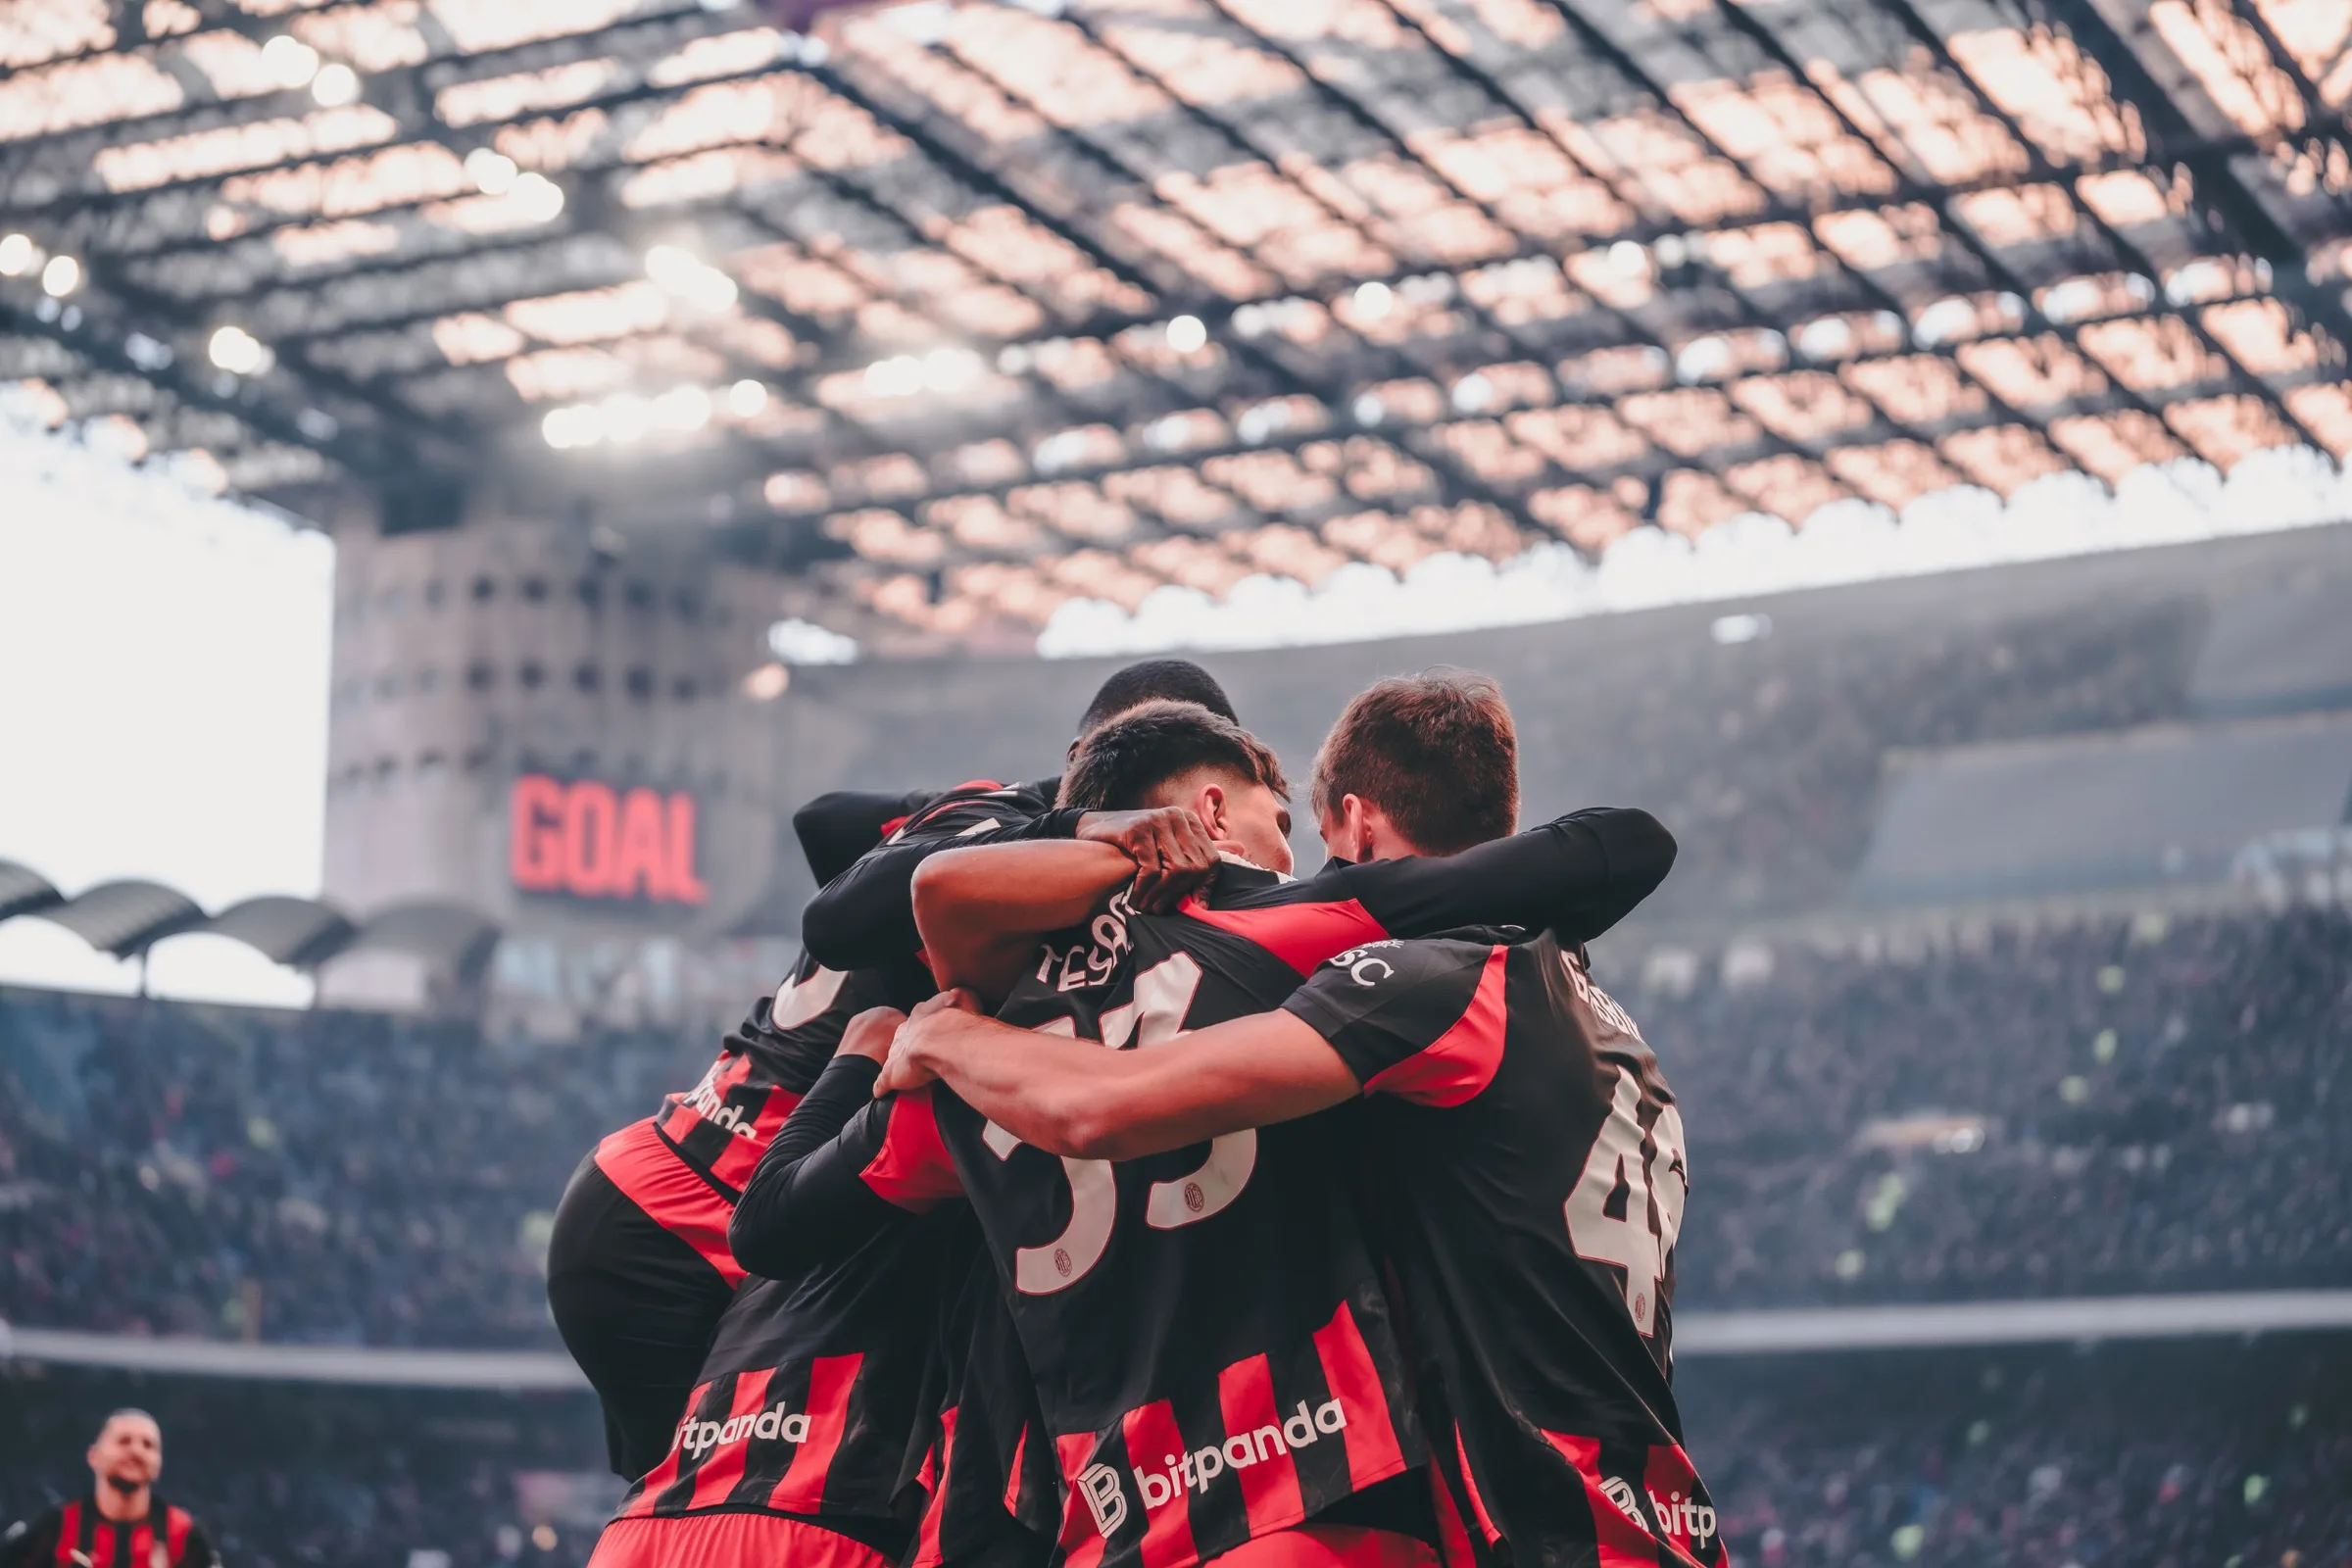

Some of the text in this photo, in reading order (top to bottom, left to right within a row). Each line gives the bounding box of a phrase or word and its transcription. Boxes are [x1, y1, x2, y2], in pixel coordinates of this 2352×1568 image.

[510, 772, 710, 906] GOAL
[1133, 1398, 1348, 1510] bitpanda
[1647, 1489, 1717, 1550] bitp
